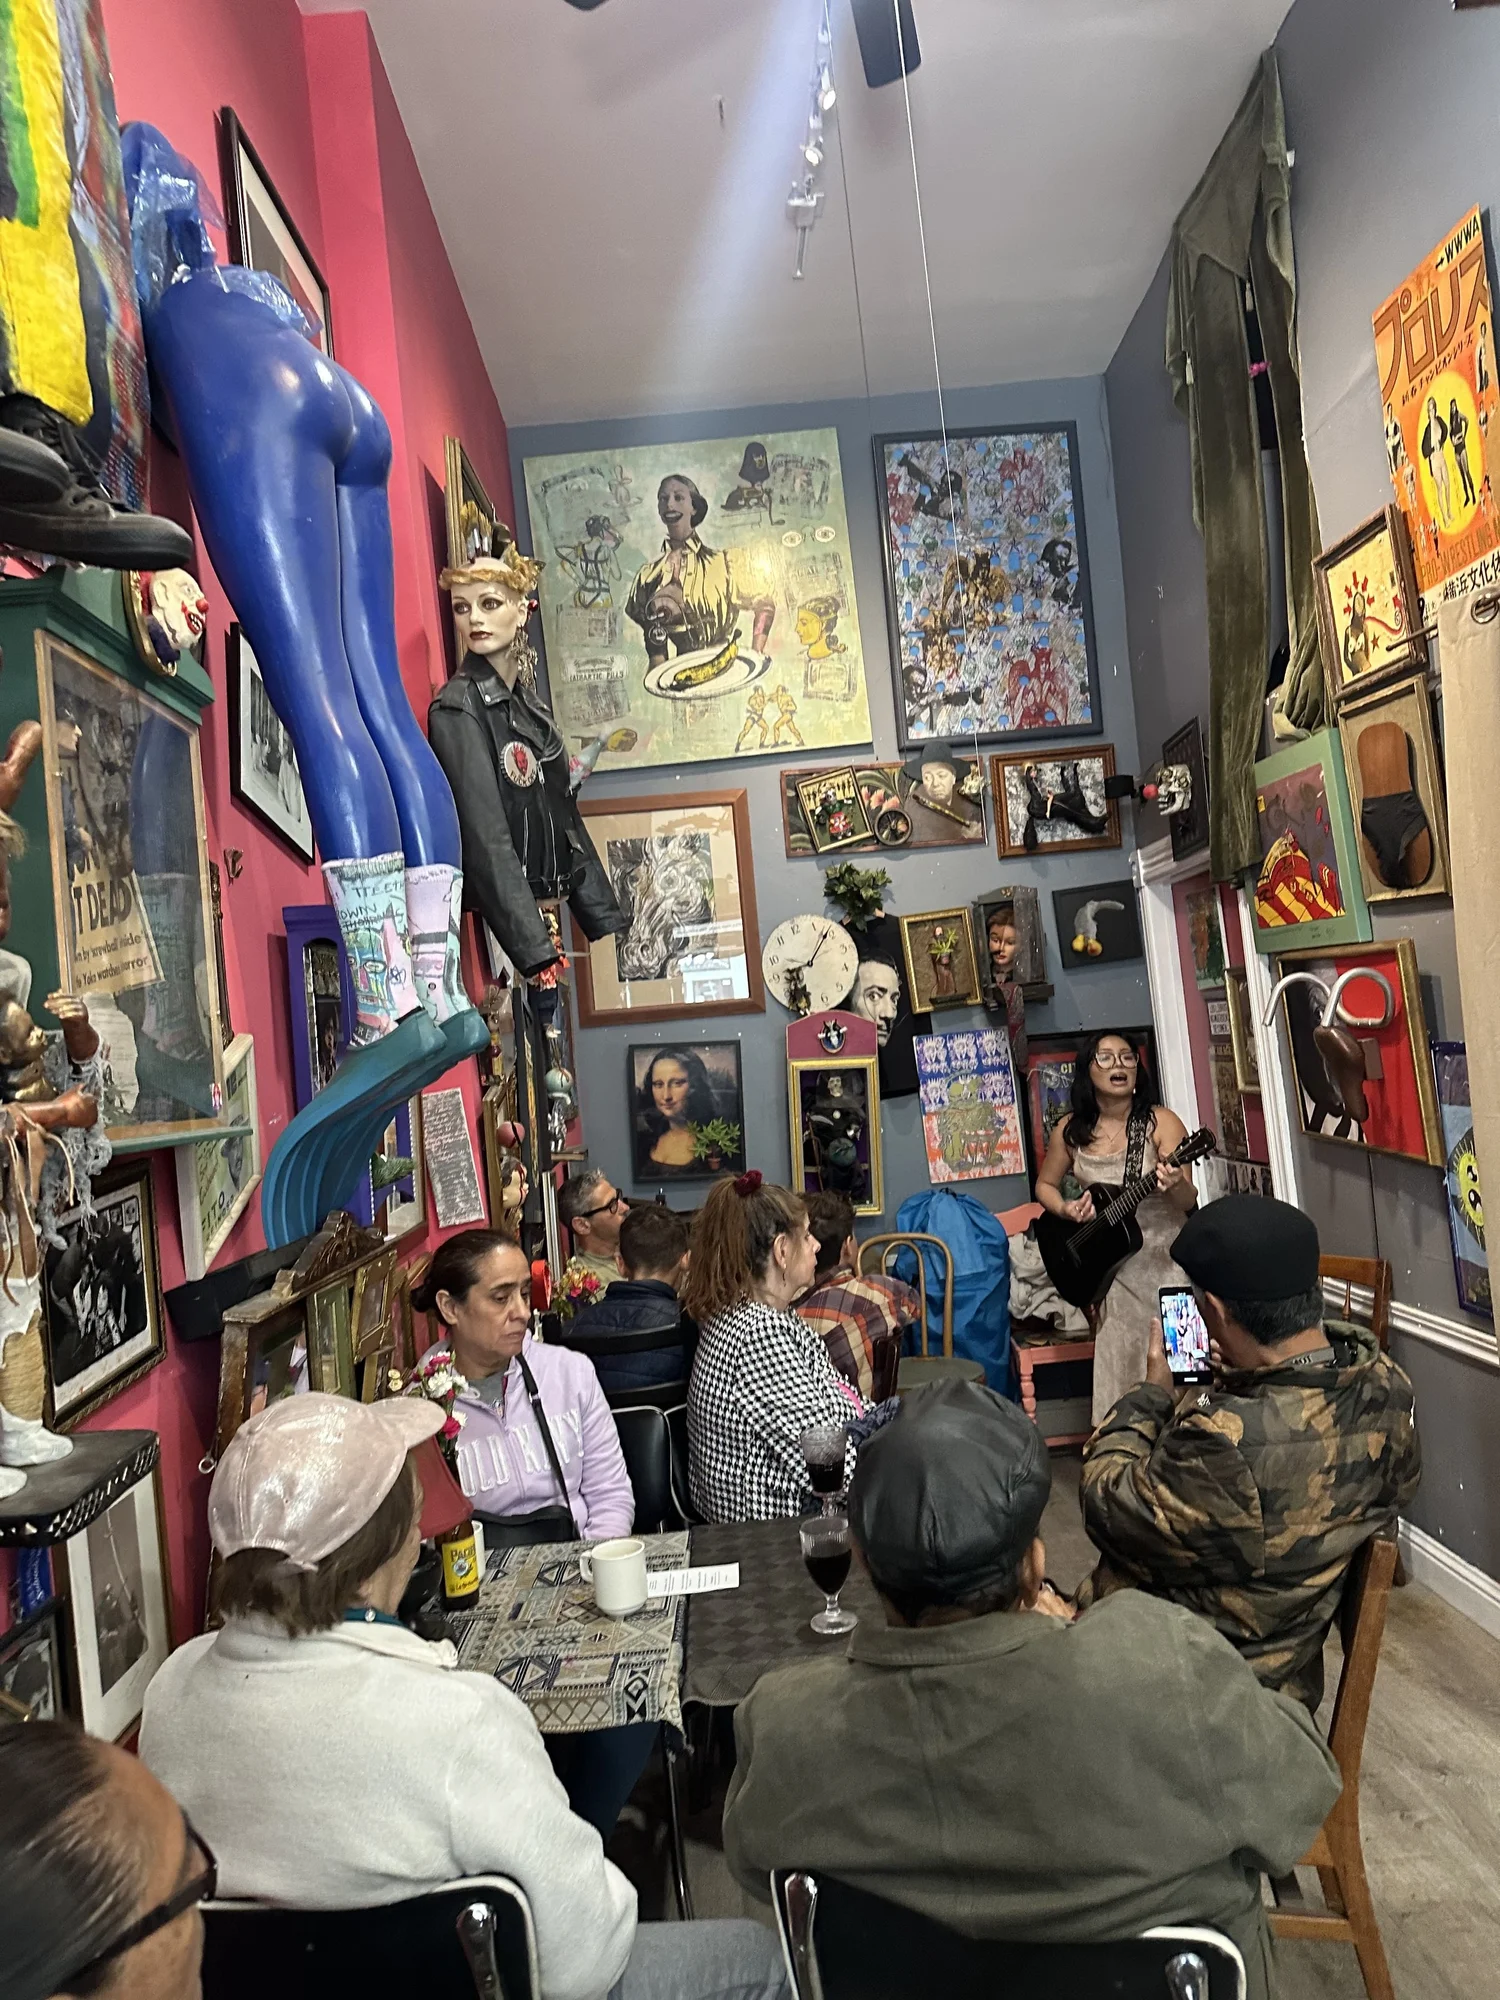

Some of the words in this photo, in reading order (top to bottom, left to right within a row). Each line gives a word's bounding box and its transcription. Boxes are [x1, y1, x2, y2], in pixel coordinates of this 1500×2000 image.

[1444, 215, 1480, 263] WWWA
[1373, 241, 1489, 406] プロレス
[790, 923, 801, 935] 12
[776, 935, 785, 946] 11
[839, 943, 848, 954] 3
[768, 954, 780, 966] 10
[841, 962, 849, 972] 4
[835, 981, 844, 992] 5
[457, 1435, 510, 1497] OLD
